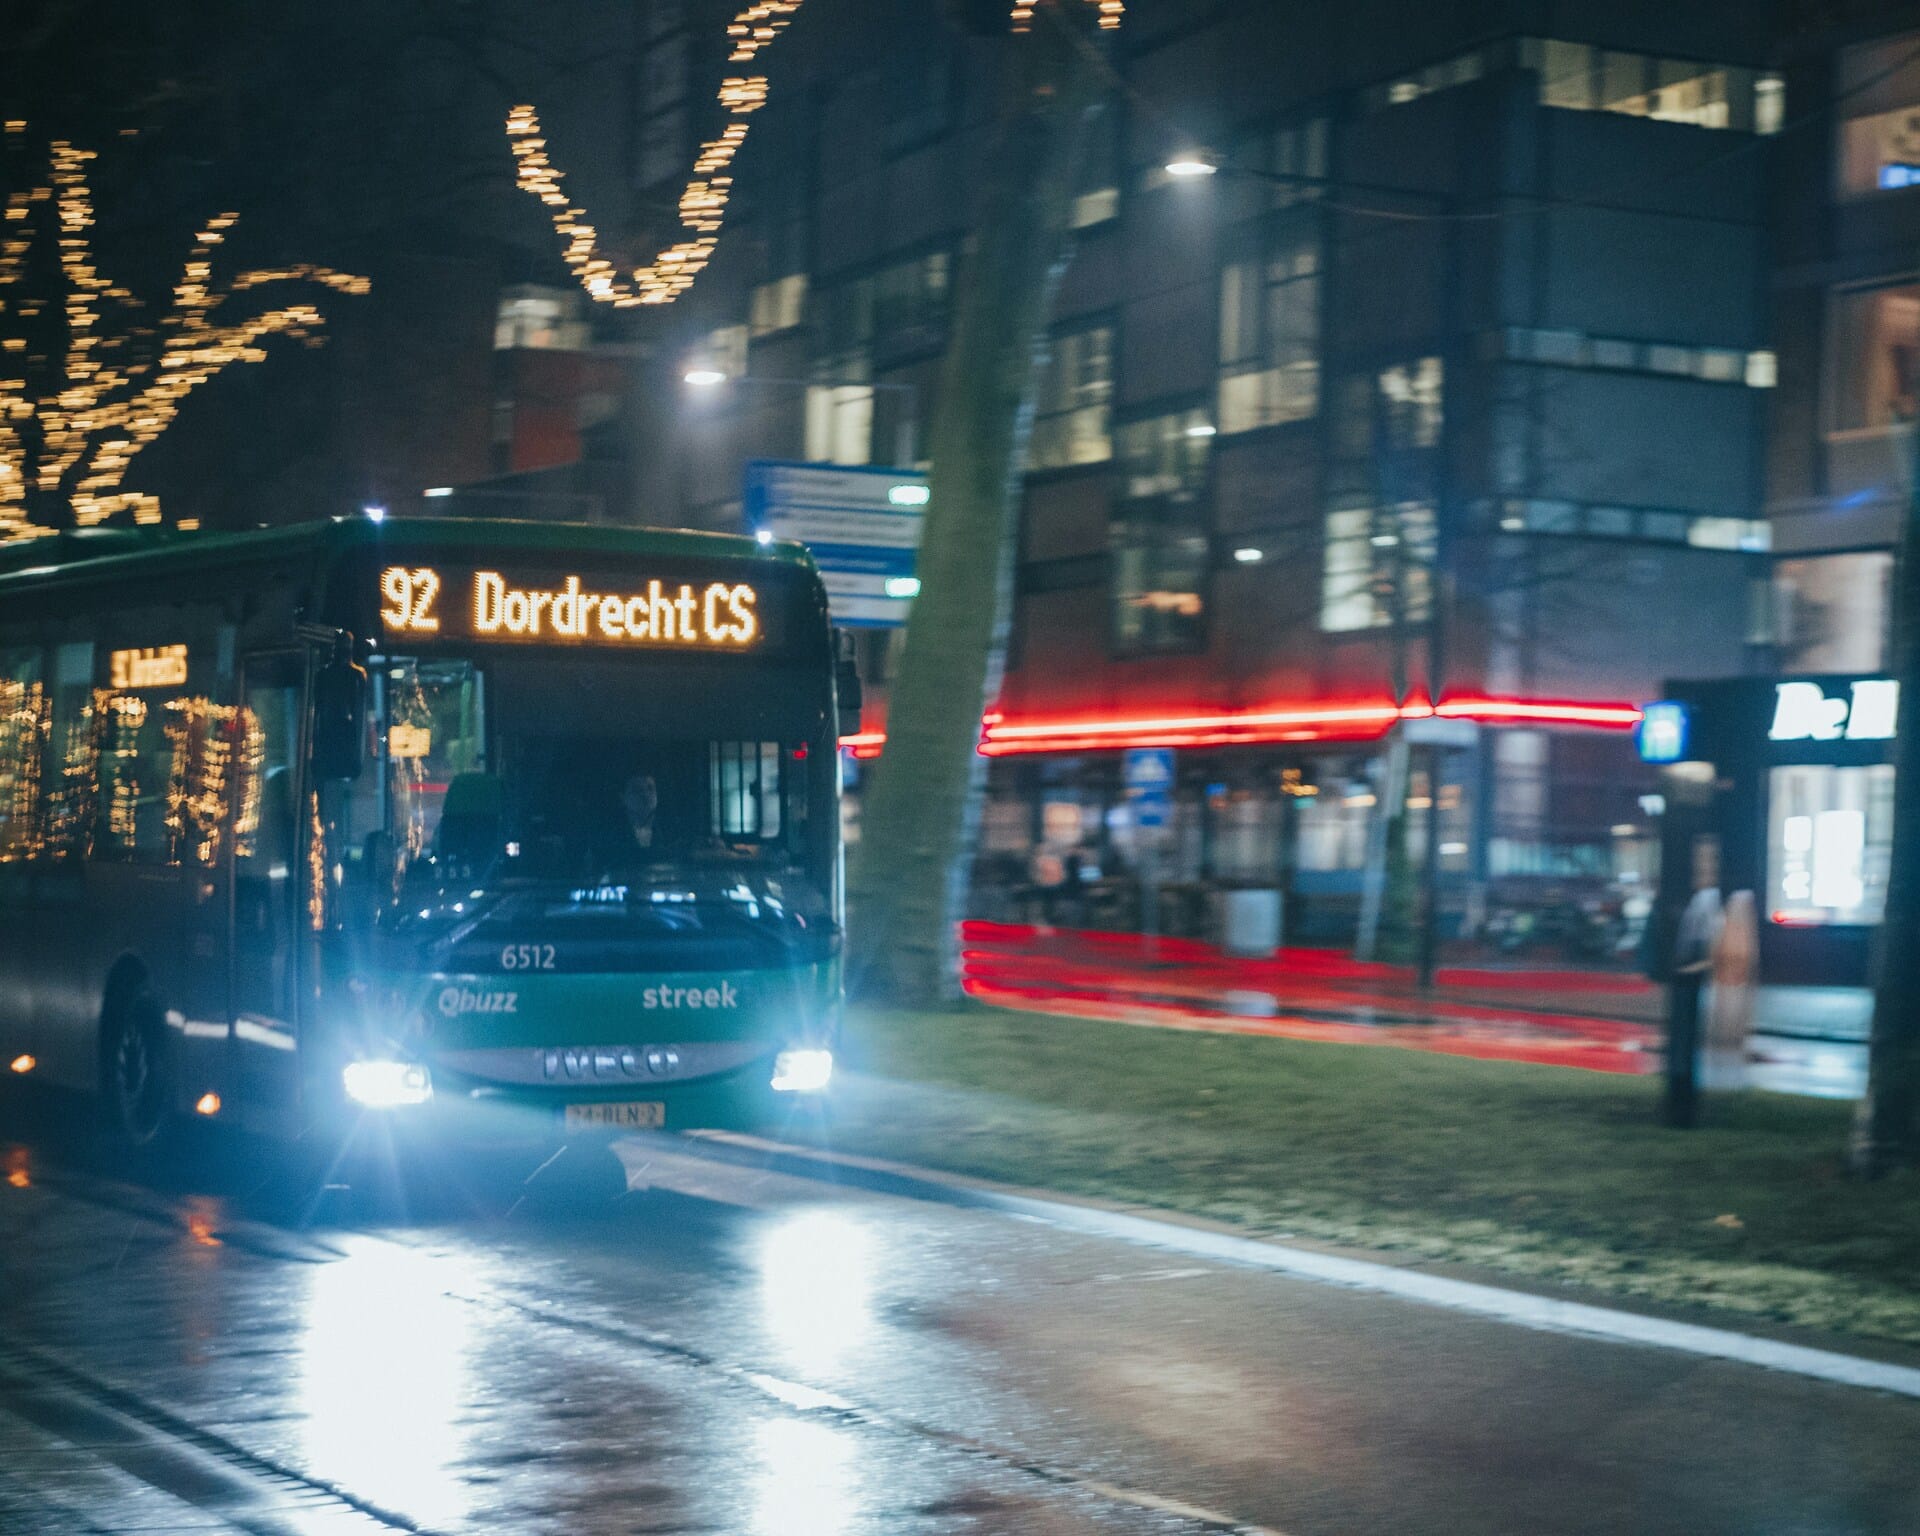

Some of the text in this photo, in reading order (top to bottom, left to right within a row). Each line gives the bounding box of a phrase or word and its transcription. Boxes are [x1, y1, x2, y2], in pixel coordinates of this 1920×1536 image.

[380, 567, 758, 643] 92 Dordrecht CS
[502, 944, 556, 970] 6512
[438, 987, 518, 1016] Qbuzz
[643, 980, 737, 1009] streek
